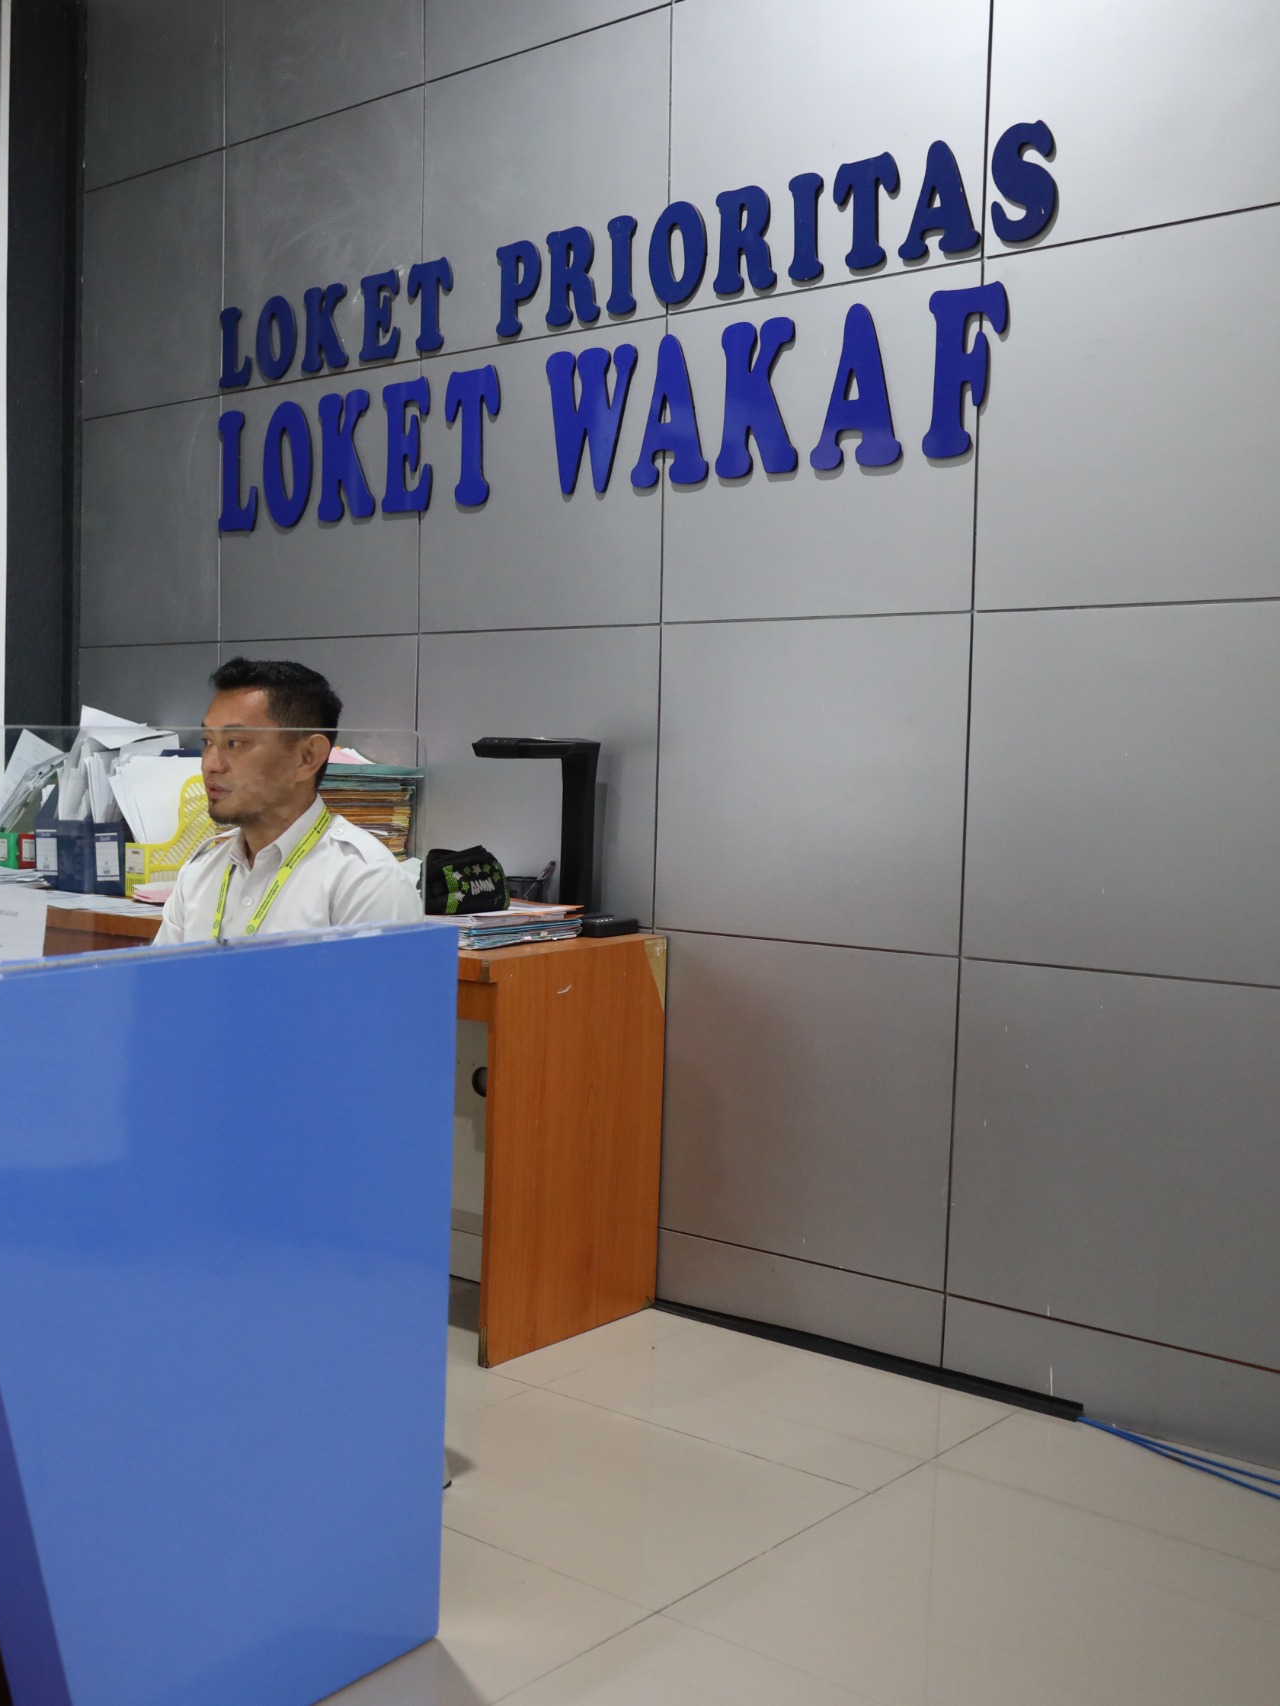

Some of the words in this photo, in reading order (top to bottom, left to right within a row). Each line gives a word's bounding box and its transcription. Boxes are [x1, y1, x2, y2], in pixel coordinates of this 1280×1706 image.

[218, 256, 454, 389] LOKET
[495, 120, 1058, 337] PRIORITAS
[217, 363, 501, 532] LOKET
[545, 281, 1011, 495] WAKAF
